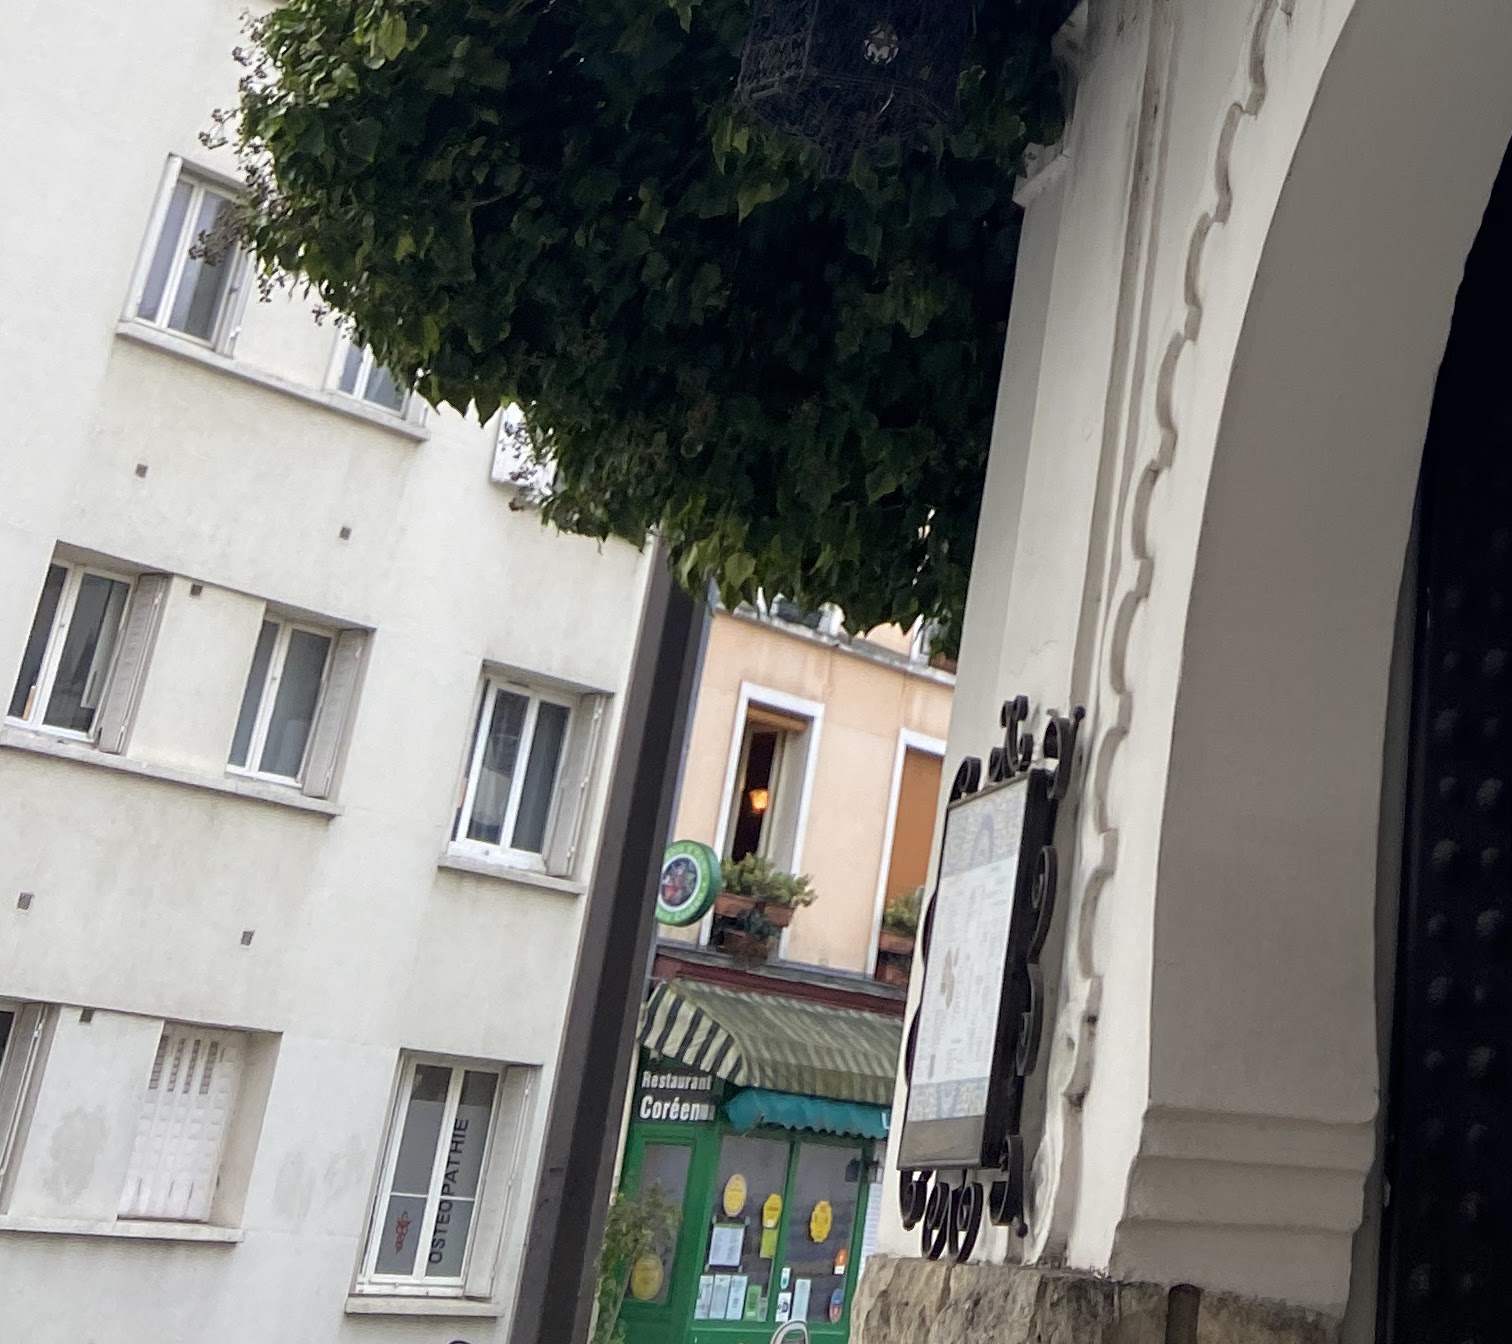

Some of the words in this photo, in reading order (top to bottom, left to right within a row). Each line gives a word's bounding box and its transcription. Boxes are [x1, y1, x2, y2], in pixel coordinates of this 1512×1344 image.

[641, 1070, 712, 1090] Restaurant
[640, 1095, 702, 1121] Coréen
[428, 1118, 468, 1263] OSTEOPATHIE
